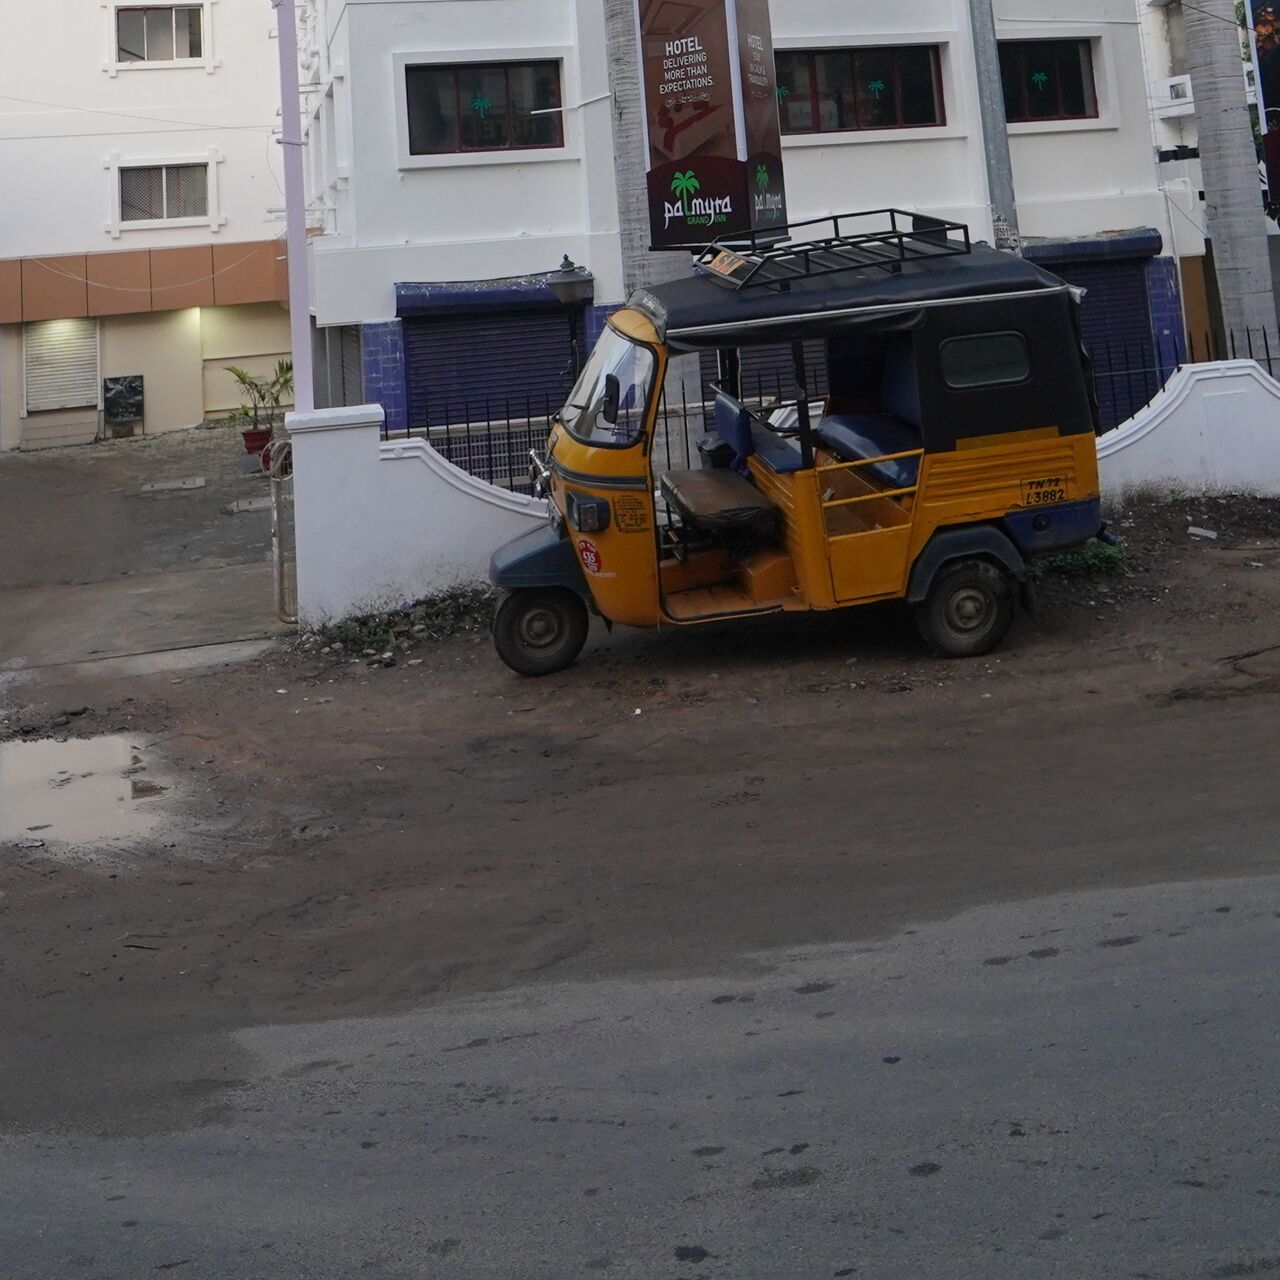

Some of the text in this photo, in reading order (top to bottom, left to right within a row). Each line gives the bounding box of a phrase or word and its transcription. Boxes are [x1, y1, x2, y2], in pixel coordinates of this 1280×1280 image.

[665, 36, 703, 56] HOTEL
[663, 52, 707, 69] DELIVERING
[664, 65, 708, 81] MORE THAN
[659, 76, 715, 94] EXPECTATIONS.
[664, 184, 732, 229] palmyra
[687, 216, 709, 225] GRAND
[1028, 479, 1045, 489] TN
